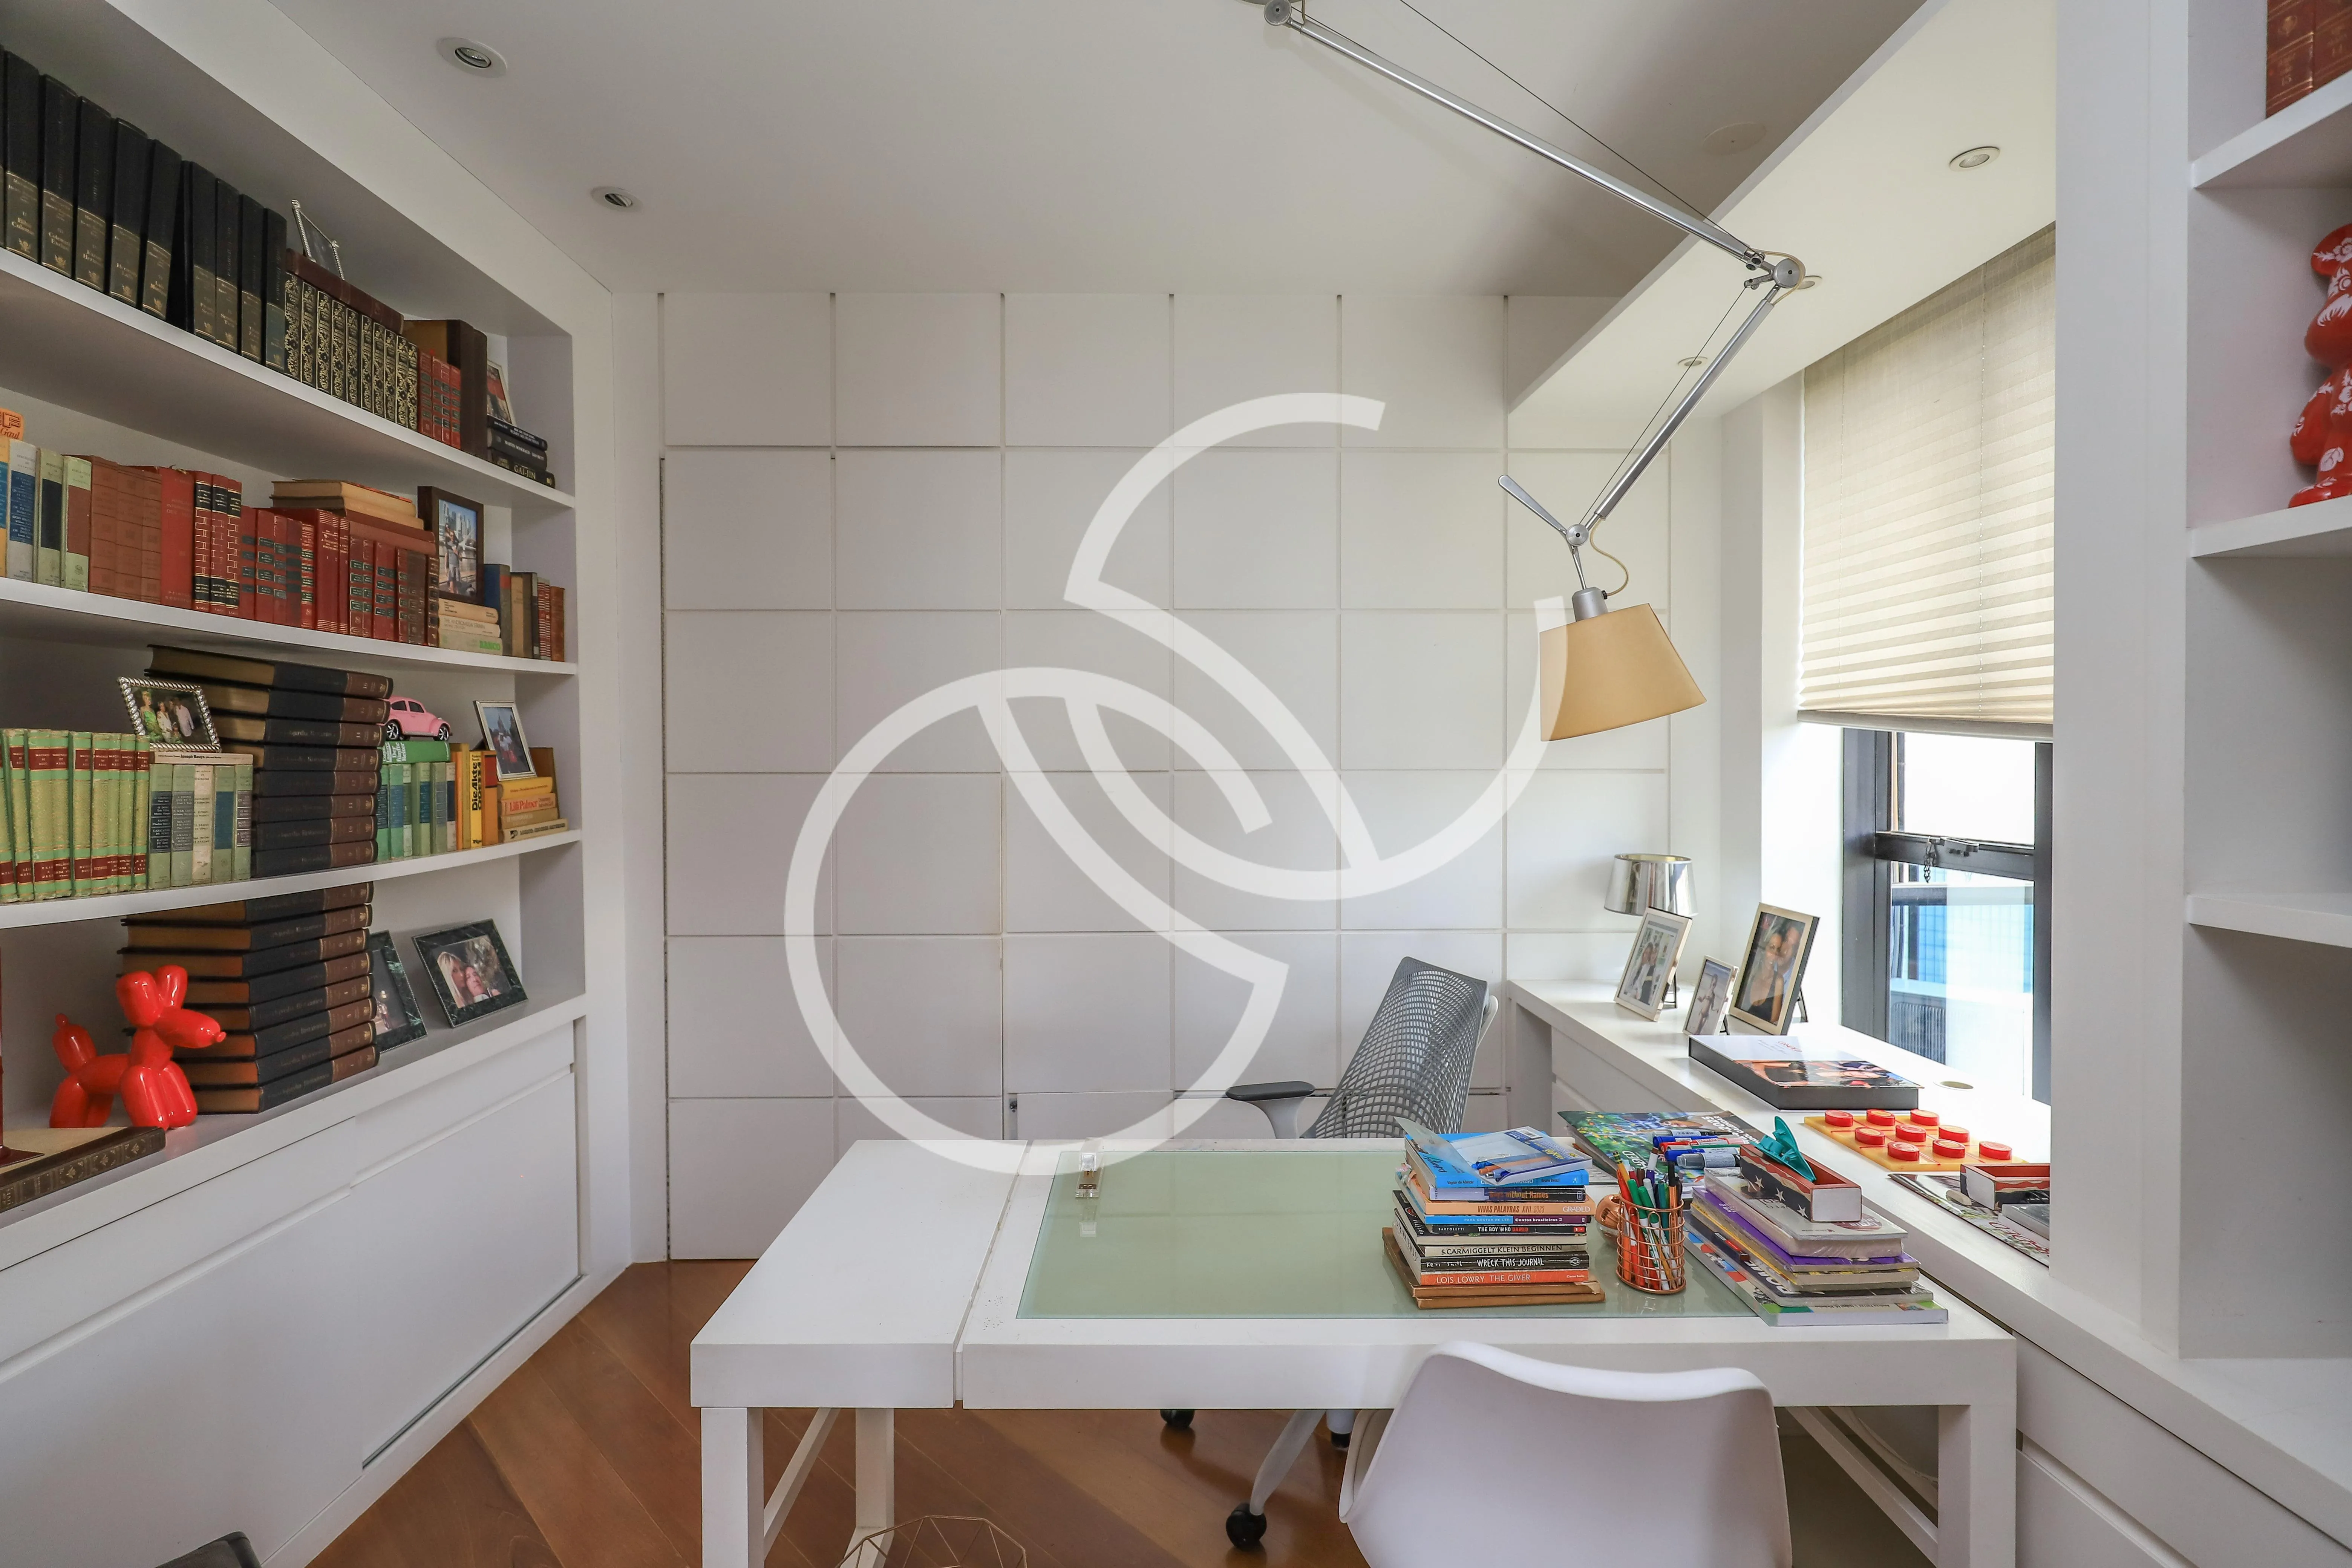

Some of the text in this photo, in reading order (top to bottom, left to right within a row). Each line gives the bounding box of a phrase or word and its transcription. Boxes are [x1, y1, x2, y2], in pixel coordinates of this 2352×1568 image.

[514, 465, 536, 479] GAI-JIN
[479, 640, 501, 651] BANCO
[520, 800, 538, 810] Palmer
[1500, 1259, 1515, 1267] THIS
[1517, 1257, 1545, 1267] JOURNAL
